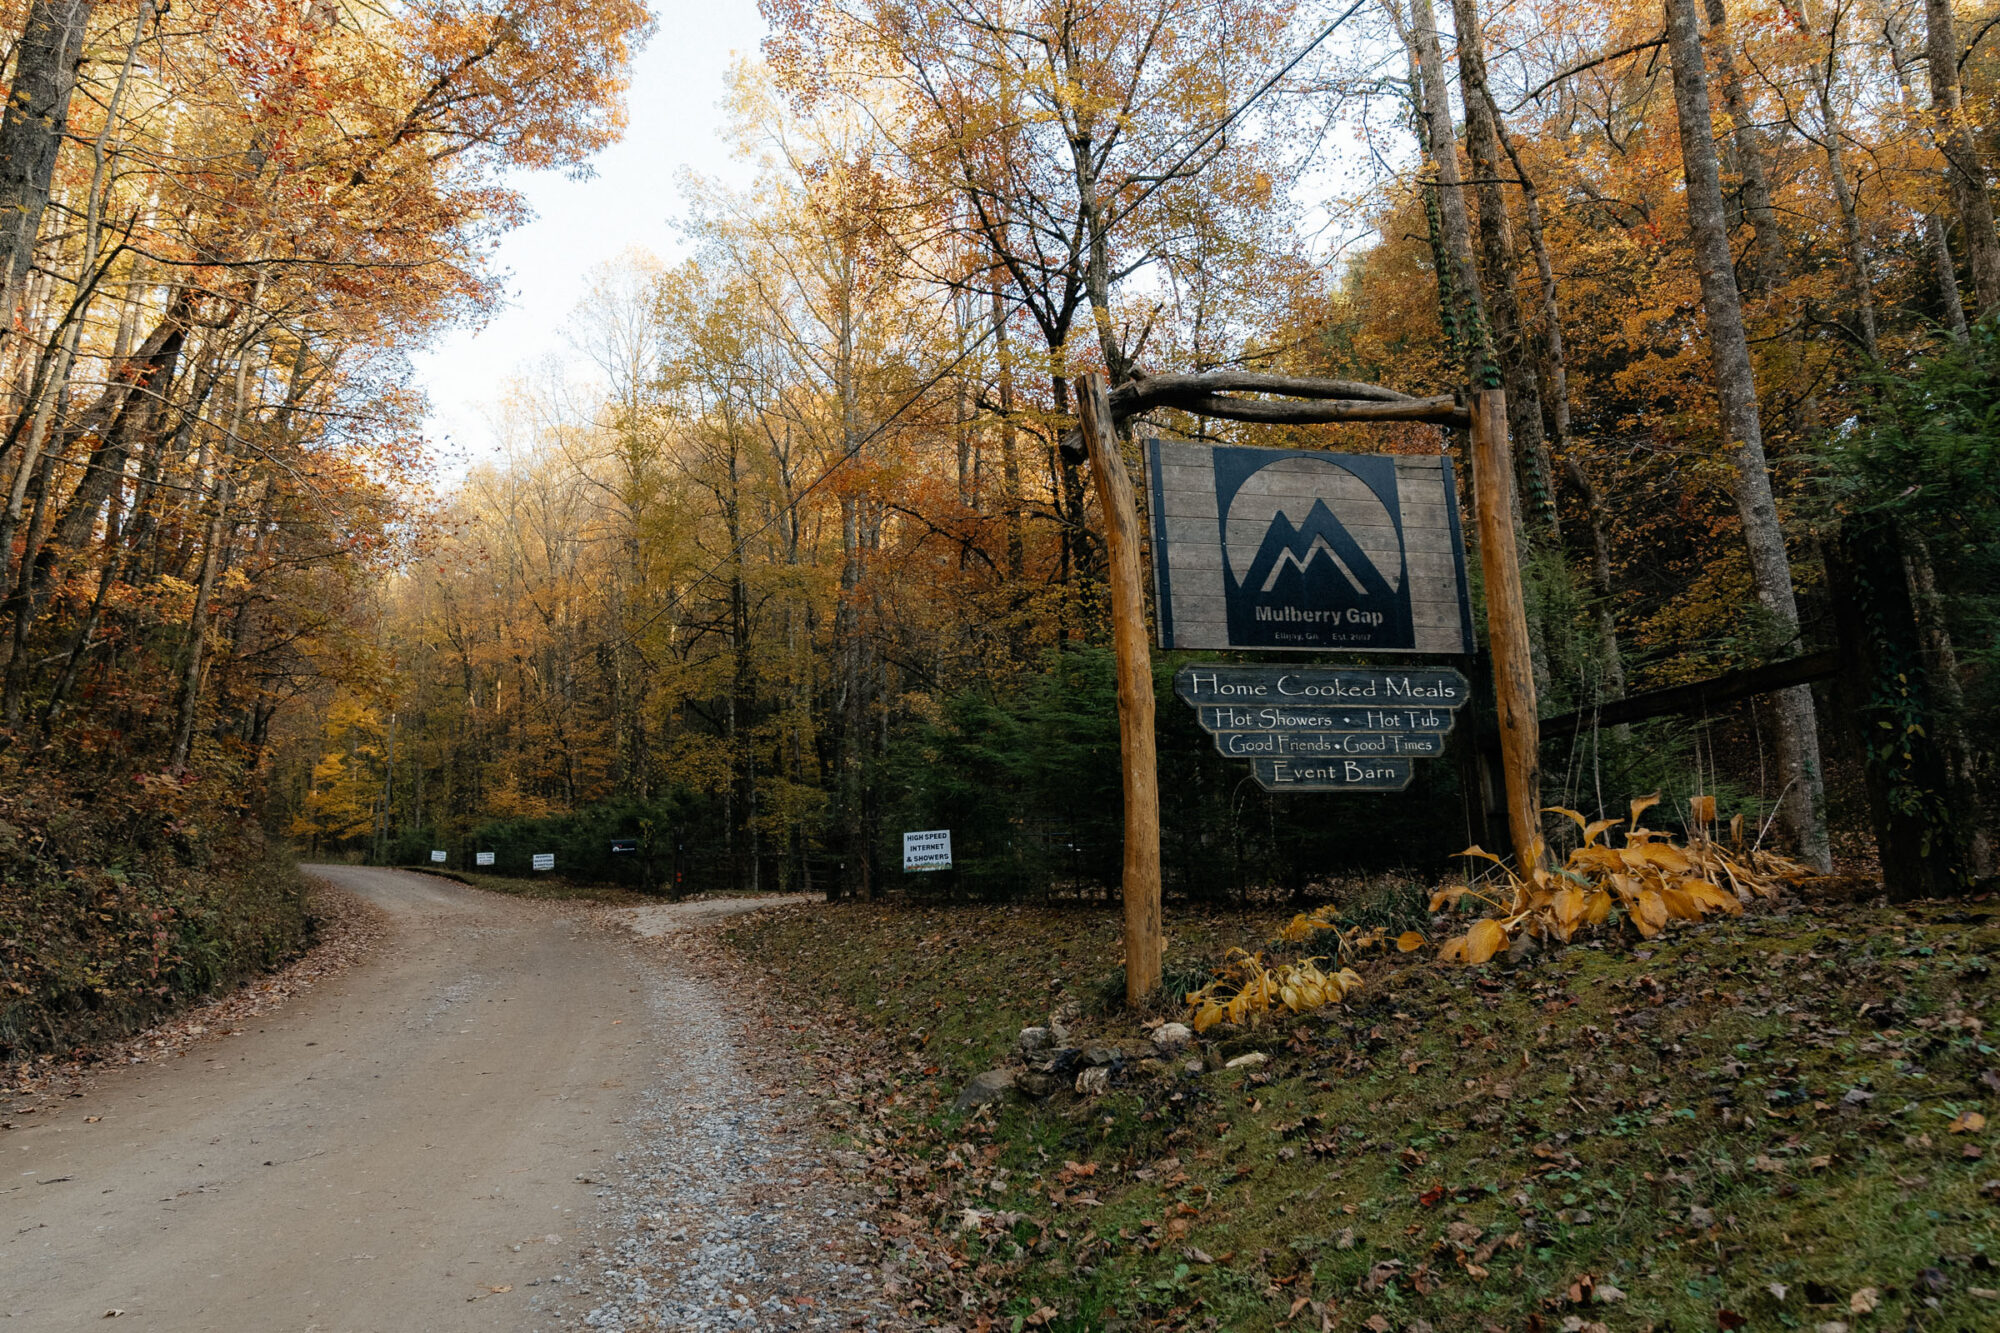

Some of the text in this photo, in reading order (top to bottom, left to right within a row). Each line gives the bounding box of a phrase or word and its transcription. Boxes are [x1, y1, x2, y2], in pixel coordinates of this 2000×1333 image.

[1255, 606, 1384, 627] Mulberry Gap
[1192, 673, 1456, 698] Home Cooked Meals
[1215, 708, 1440, 729] Hot Showers Hot Tub
[1229, 734, 1433, 754] Good Friends Good Times
[1272, 760, 1395, 782] Event Barn
[907, 832, 947, 842] HIGH SPEED
[910, 843, 945, 852] INTERNET
[913, 853, 950, 862] SHOWERS
